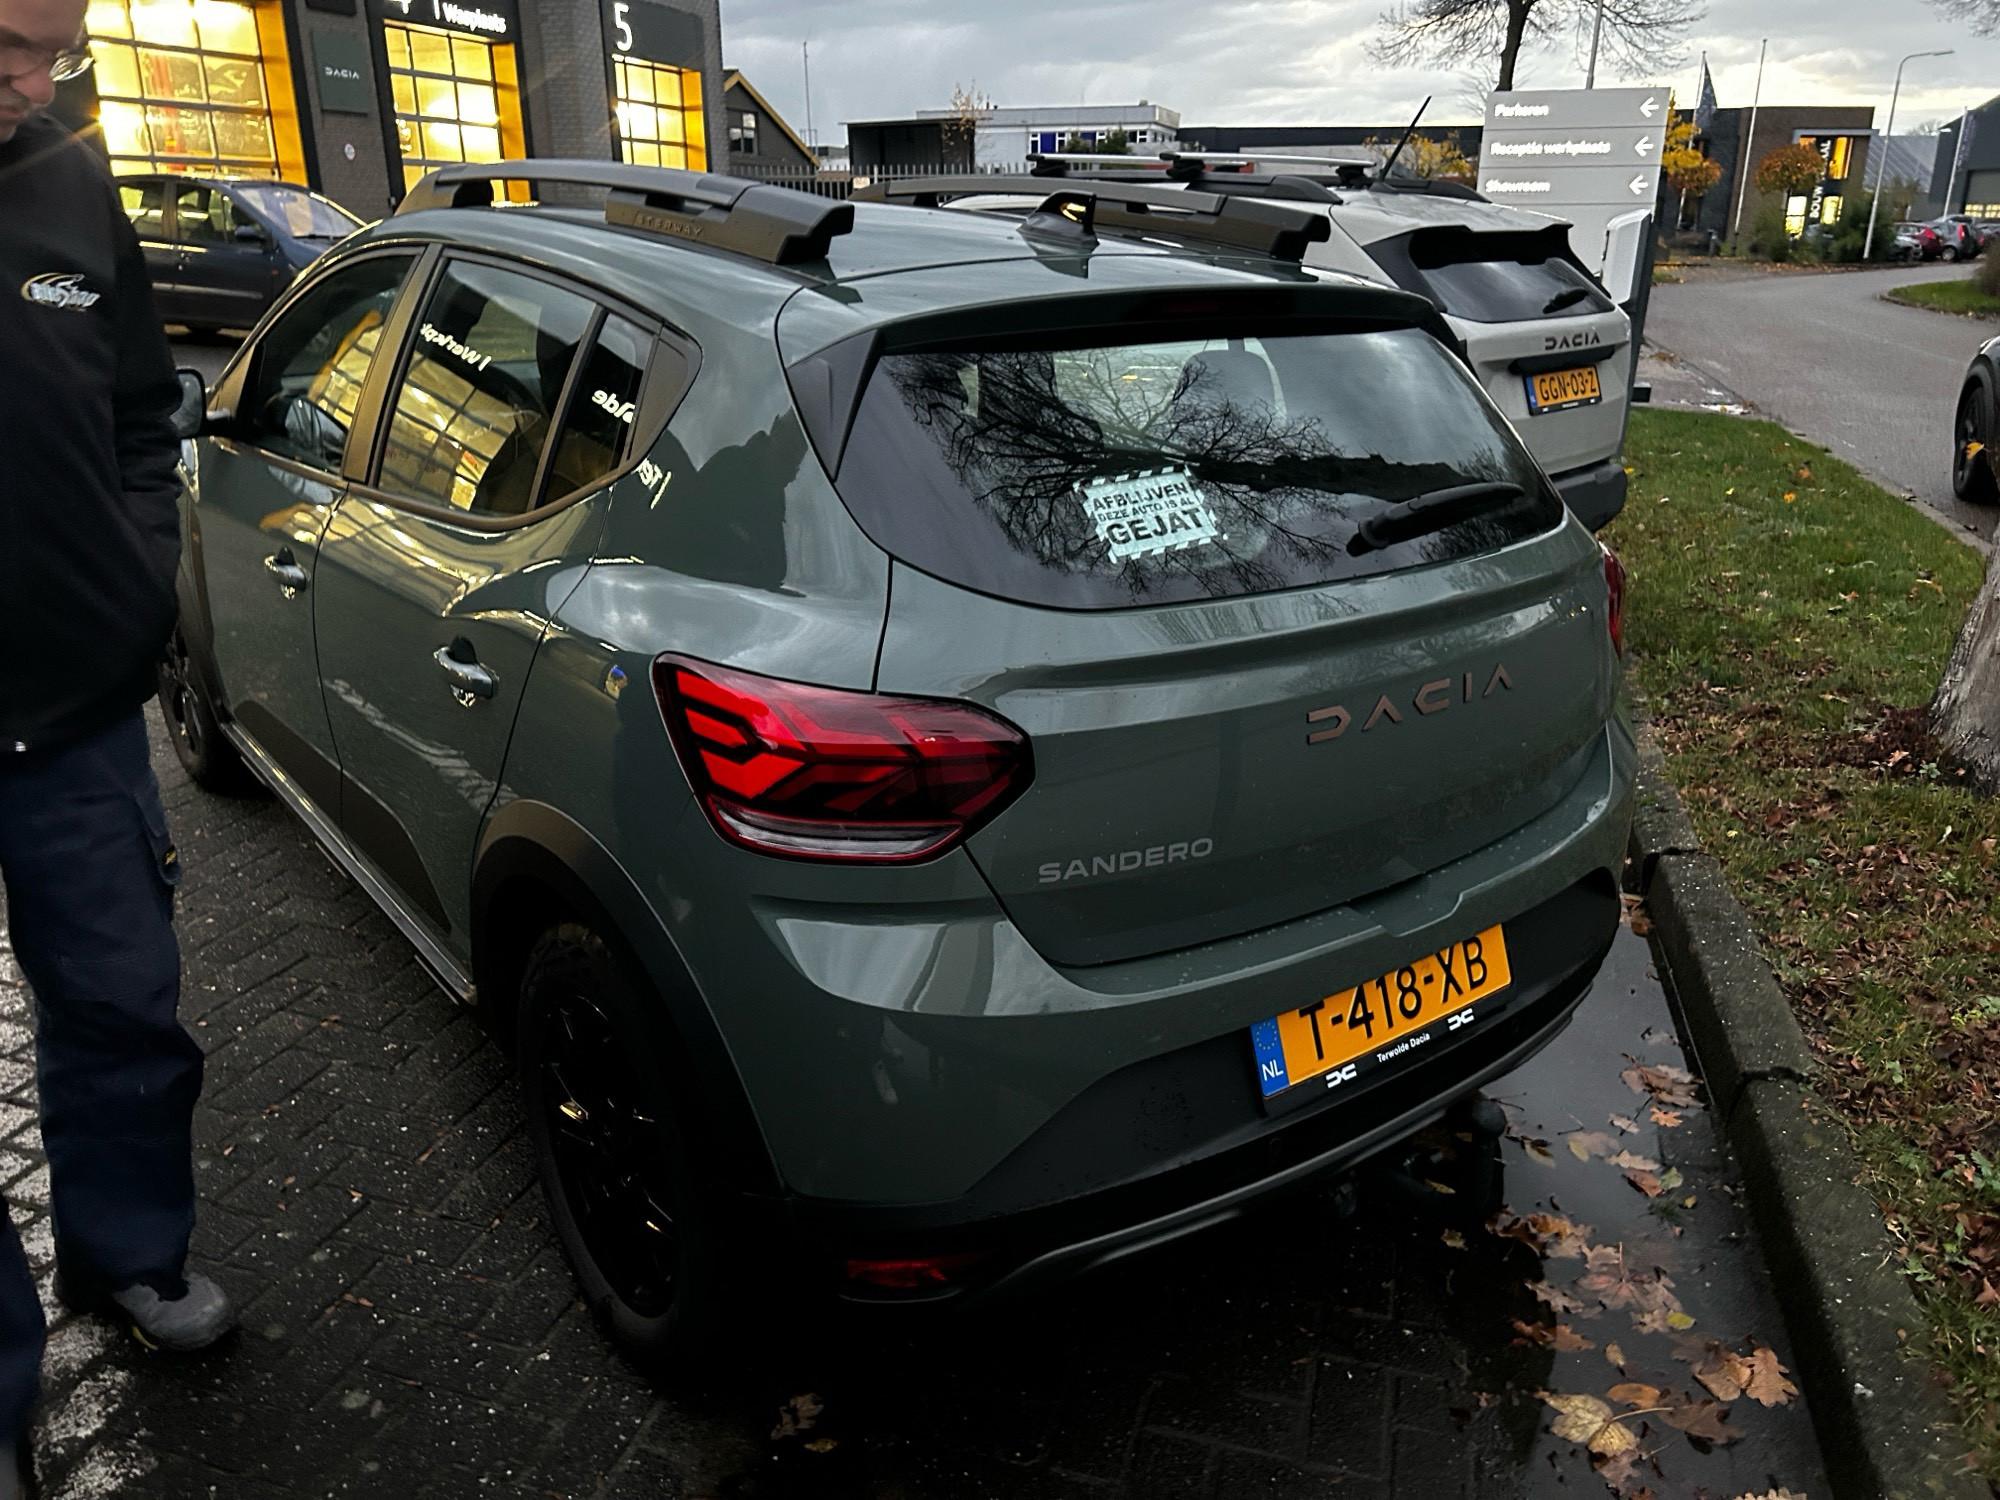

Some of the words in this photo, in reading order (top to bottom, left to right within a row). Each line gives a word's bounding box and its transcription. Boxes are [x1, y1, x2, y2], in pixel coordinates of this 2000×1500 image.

[614, 2, 633, 52] 5
[325, 66, 360, 80] DACIA
[1494, 103, 1549, 117] Parkeren
[1490, 142, 1543, 157] Receptie
[1543, 141, 1611, 156] werkplaats
[1485, 179, 1551, 193] Showroom
[1544, 332, 1601, 351] DACIA
[1539, 369, 1597, 402] GGN-03-Z
[1093, 482, 1189, 512] AFBLIJVEN
[1097, 508, 1130, 522] DEZE
[1131, 502, 1164, 517] AUTO
[1165, 499, 1178, 510] IS
[1179, 496, 1196, 507] AL
[1105, 507, 1204, 545] GEJAT
[1306, 663, 1513, 745] DACIA
[1038, 837, 1214, 884] SANDERO
[1300, 936, 1488, 1061] T-418-XB
[1376, 1042, 1410, 1063] Terwolde
[1409, 1032, 1430, 1048] Dacia
[1261, 1061, 1284, 1081] NL
